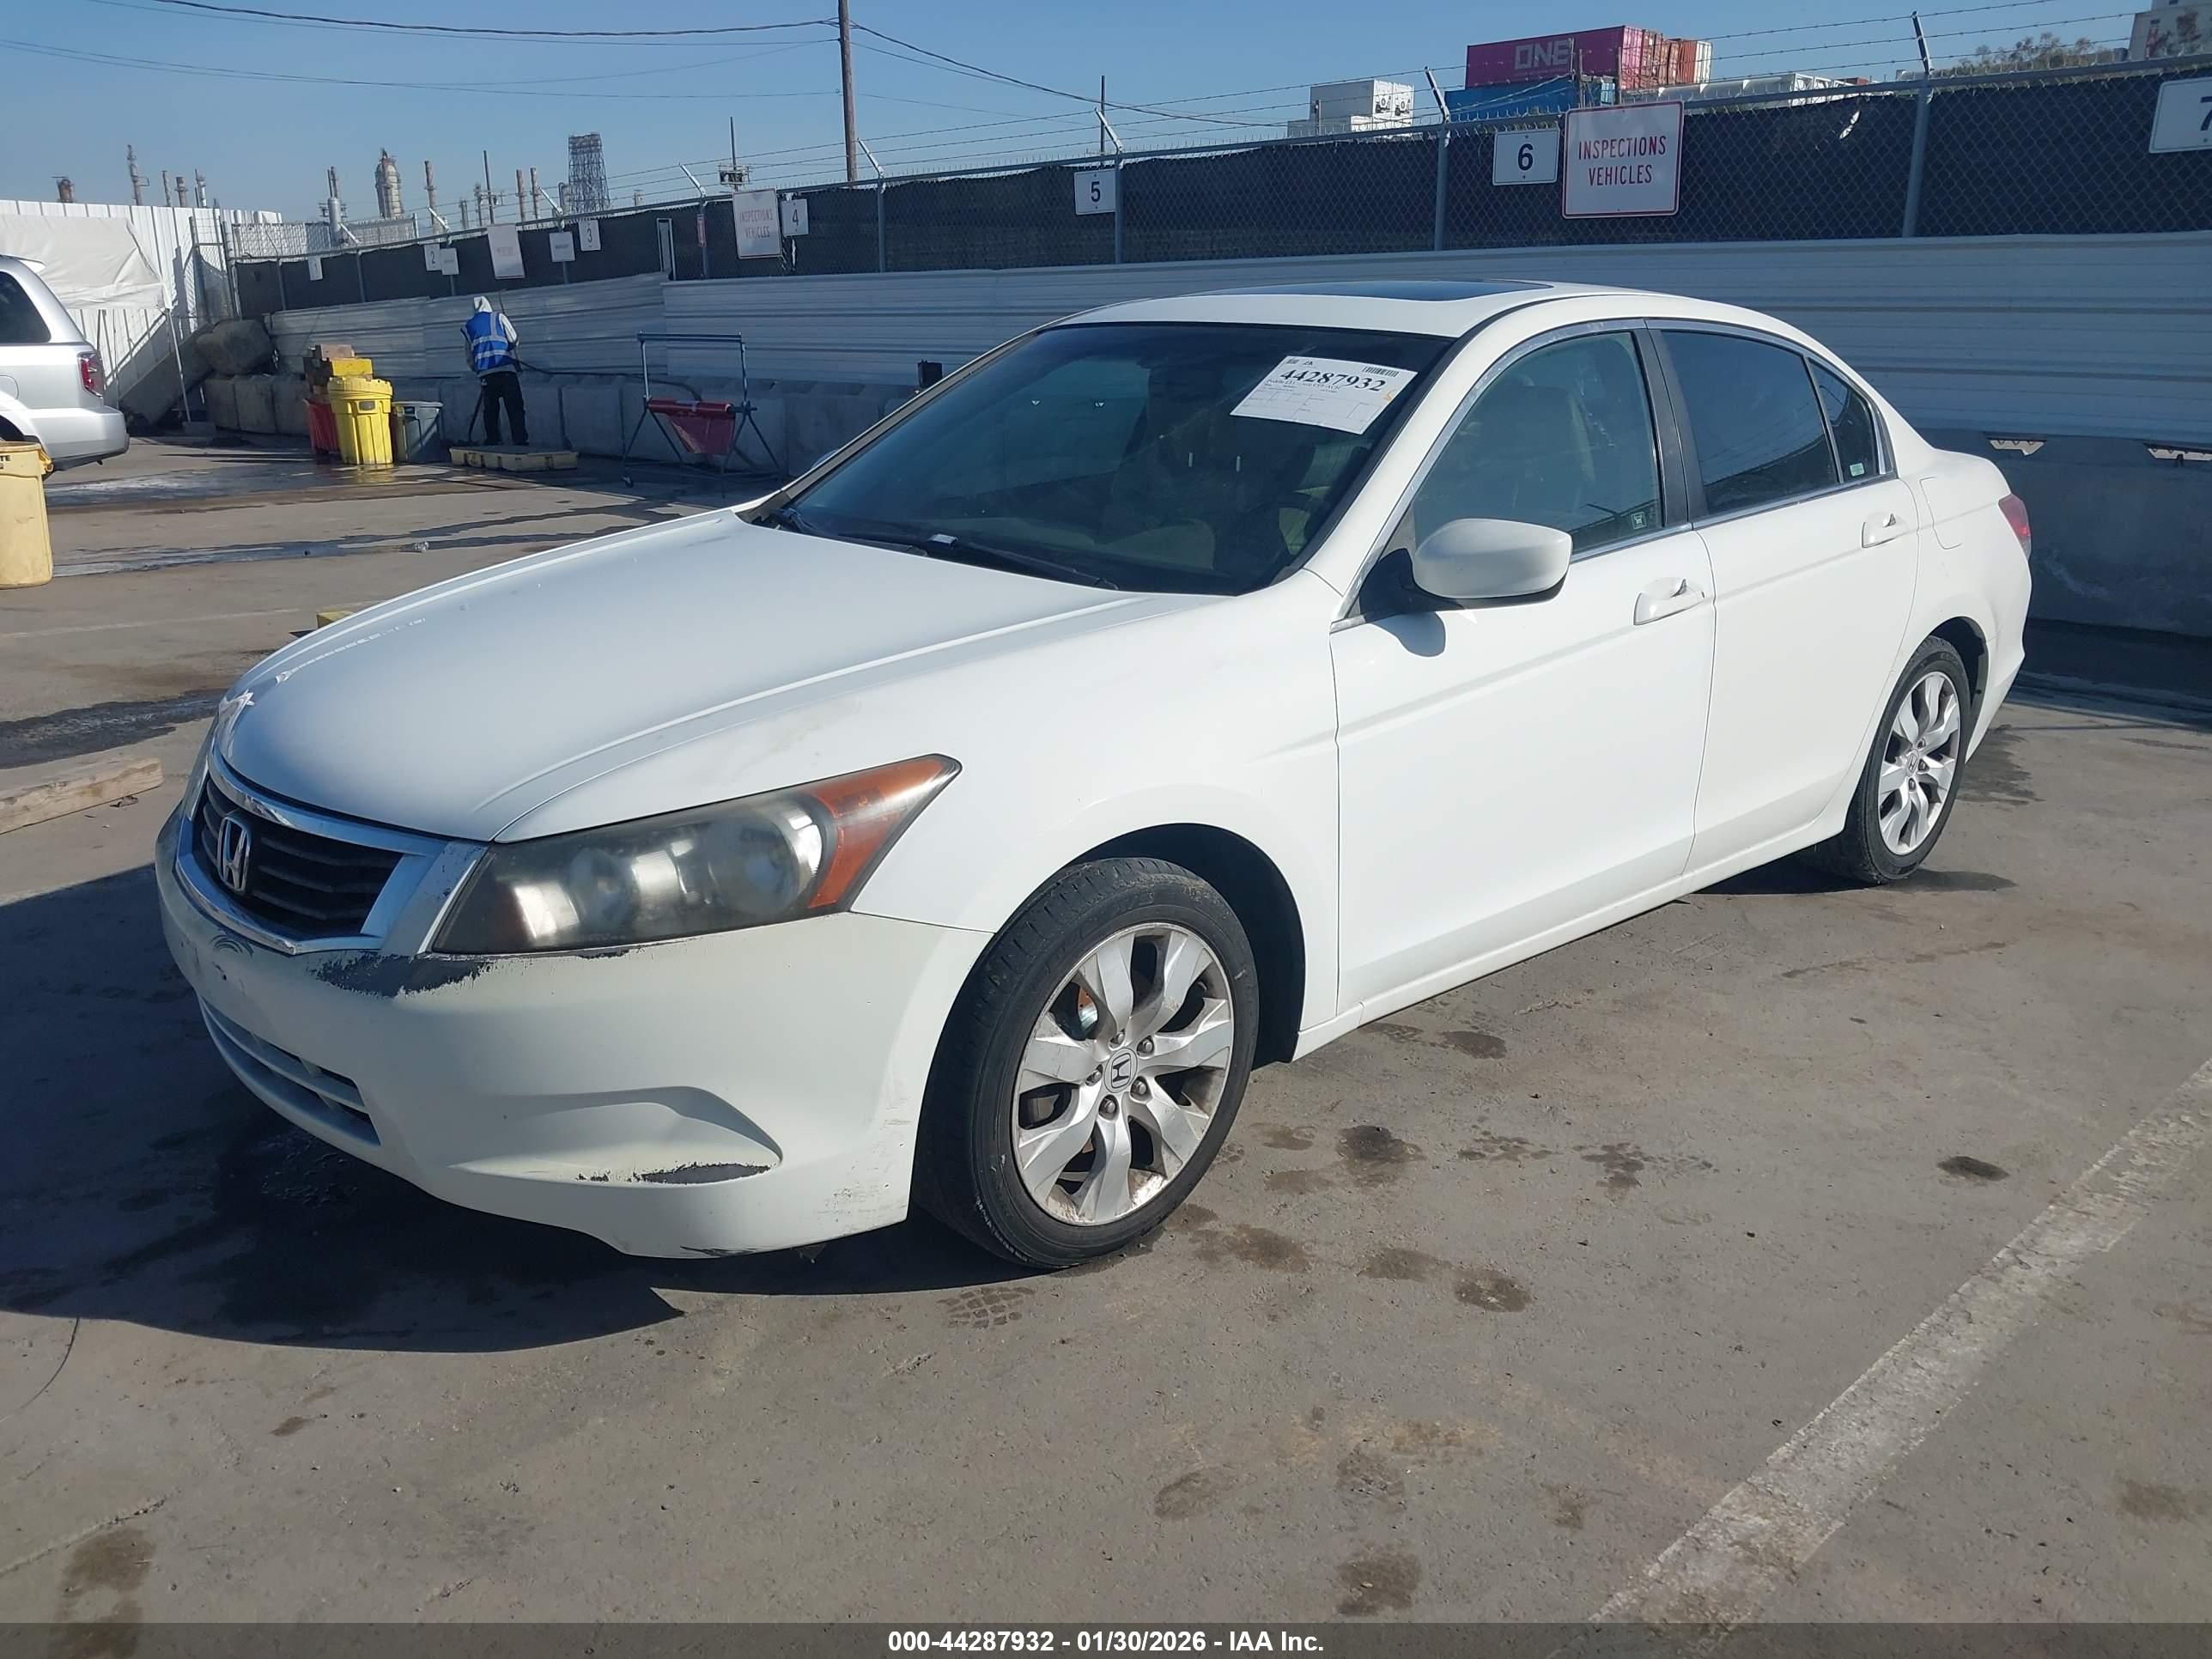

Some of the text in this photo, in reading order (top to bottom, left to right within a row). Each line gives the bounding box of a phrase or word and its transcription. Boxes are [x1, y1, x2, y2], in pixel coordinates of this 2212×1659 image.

[1515, 40, 1569, 69] ONE
[1517, 143, 1534, 171] 6
[1578, 136, 1667, 161] INSPECTIONS
[1588, 164, 1653, 186] VEHICLES
[1091, 180, 1101, 203] 5
[792, 209, 799, 227] 4
[586, 228, 592, 243] 3
[430, 251, 437, 264] 2
[1279, 369, 1387, 392] 44287932
